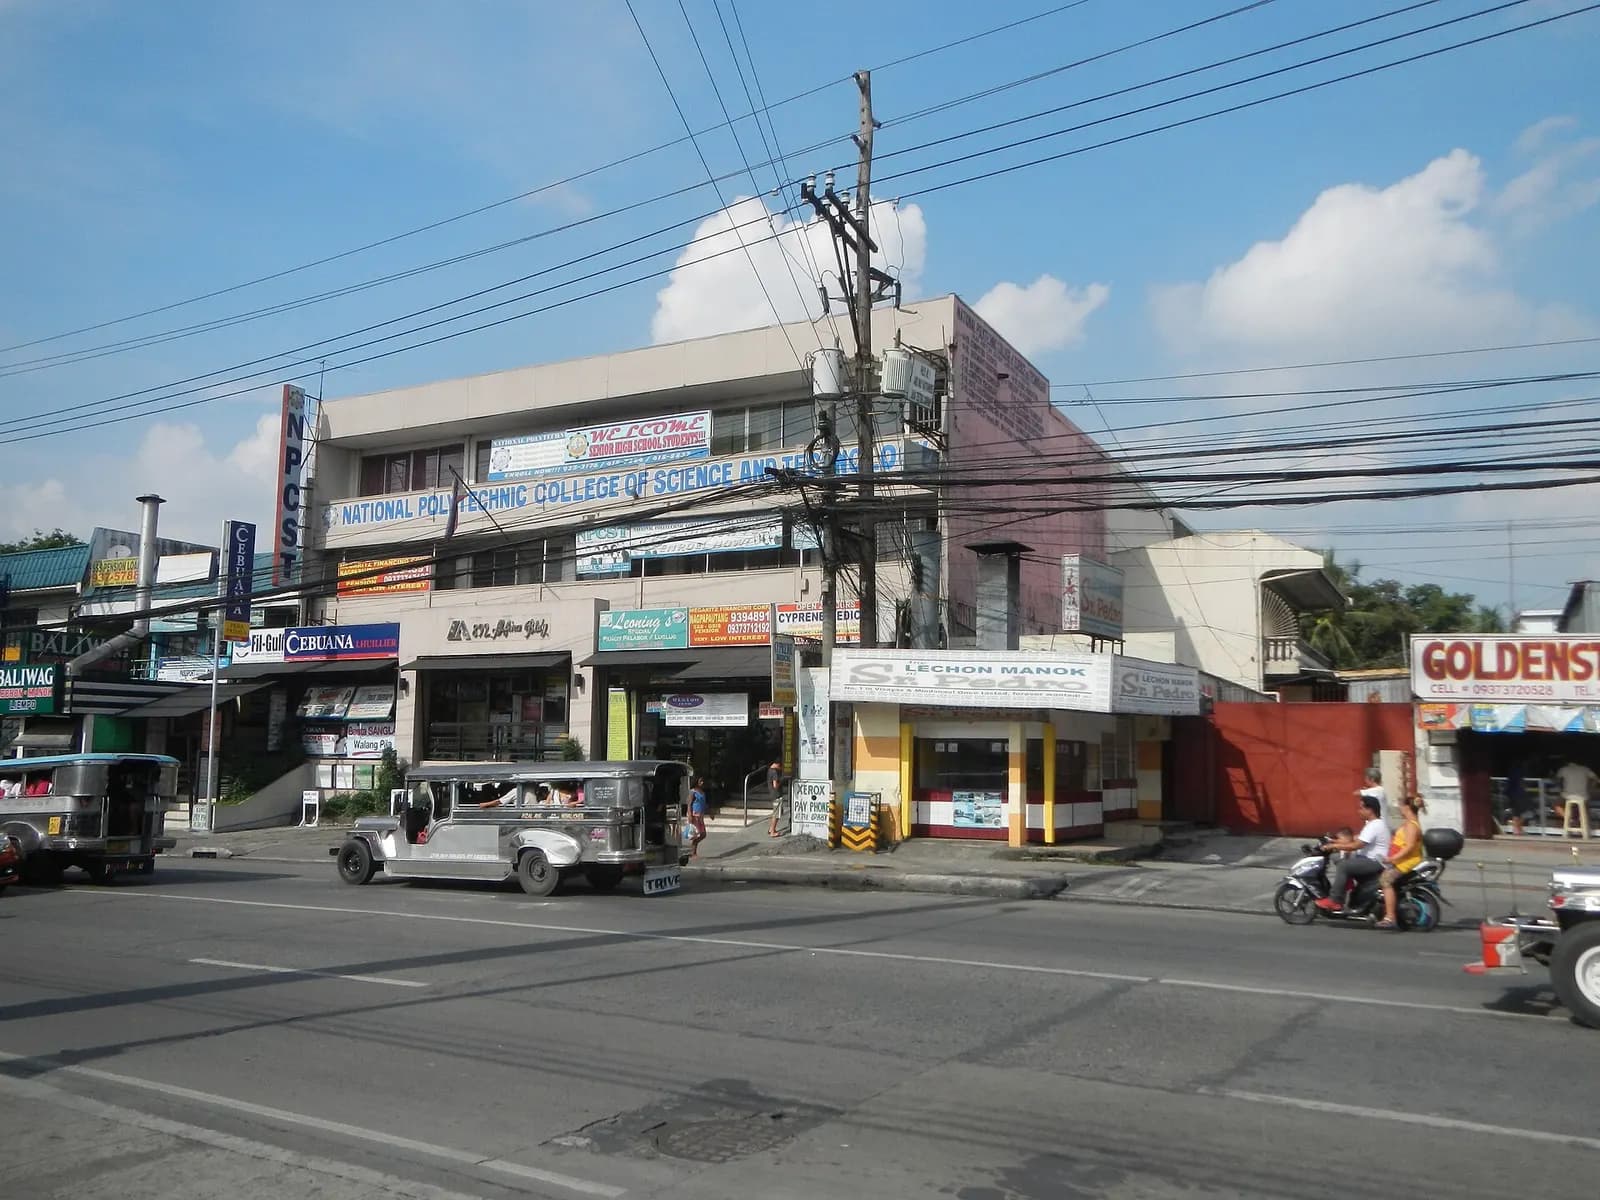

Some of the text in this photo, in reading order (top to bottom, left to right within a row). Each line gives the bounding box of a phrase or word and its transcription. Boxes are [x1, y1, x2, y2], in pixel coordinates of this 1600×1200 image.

[615, 439, 634, 454] HIGH
[634, 437, 661, 452] SCHOOL
[280, 412, 304, 579] NPCST
[342, 499, 413, 526] NATIONAL
[534, 475, 620, 505] COLLEGE
[624, 472, 648, 497] OF
[653, 462, 733, 494] SCIENCE
[740, 457, 776, 486] AND
[731, 610, 769, 622] 9394891
[286, 630, 354, 654] CEBUANA
[0, 667, 54, 687] BALIWAG
[905, 664, 1086, 676] LECHON MANOK
[797, 783, 825, 795] XEROX
[795, 801, 807, 812] PAY
